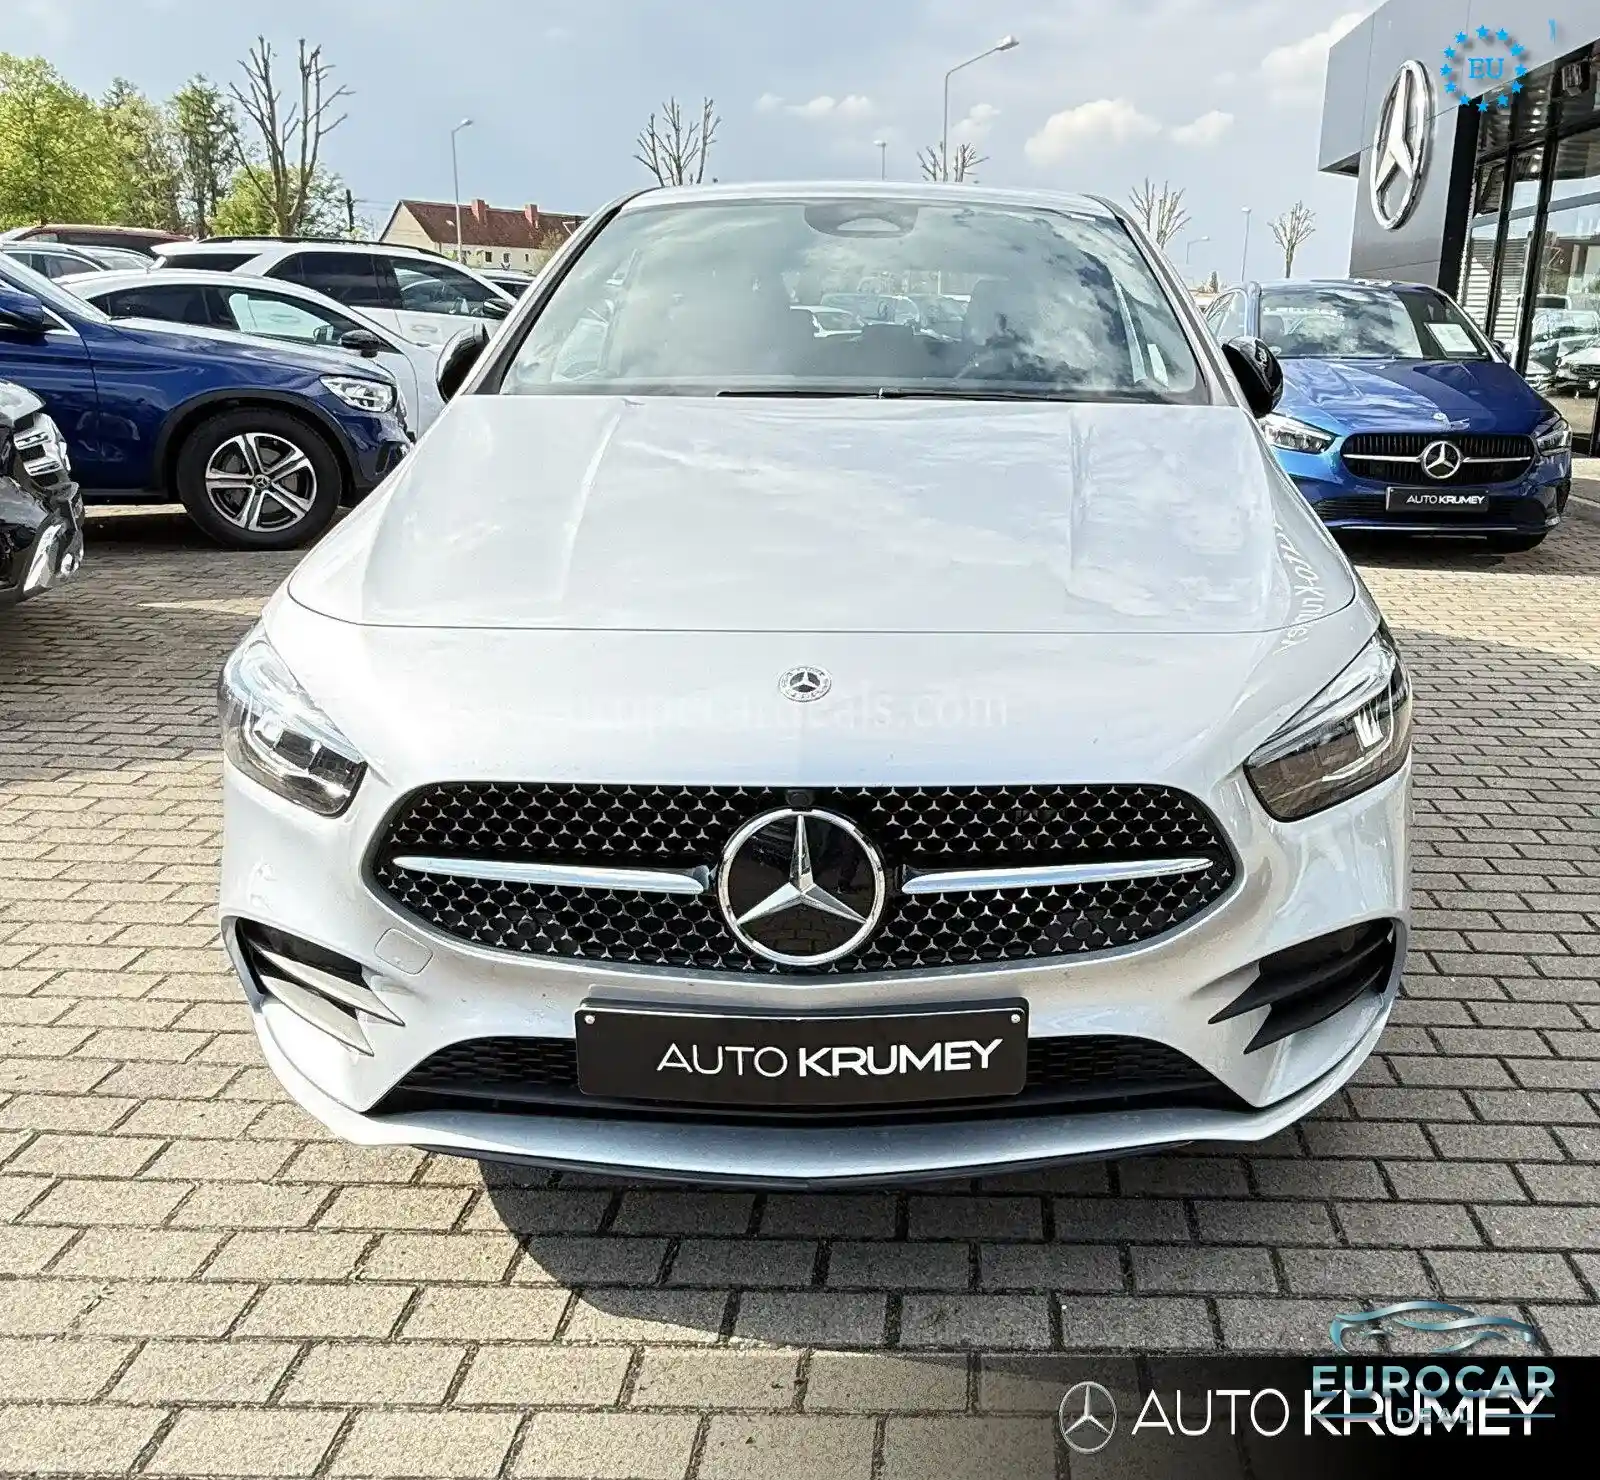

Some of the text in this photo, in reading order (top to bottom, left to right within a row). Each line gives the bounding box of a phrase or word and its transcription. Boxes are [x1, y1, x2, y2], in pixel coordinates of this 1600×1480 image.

[1406, 495, 1485, 505] AUTO KRUMEY
[656, 1038, 1004, 1078] AUTO KRUMEY
